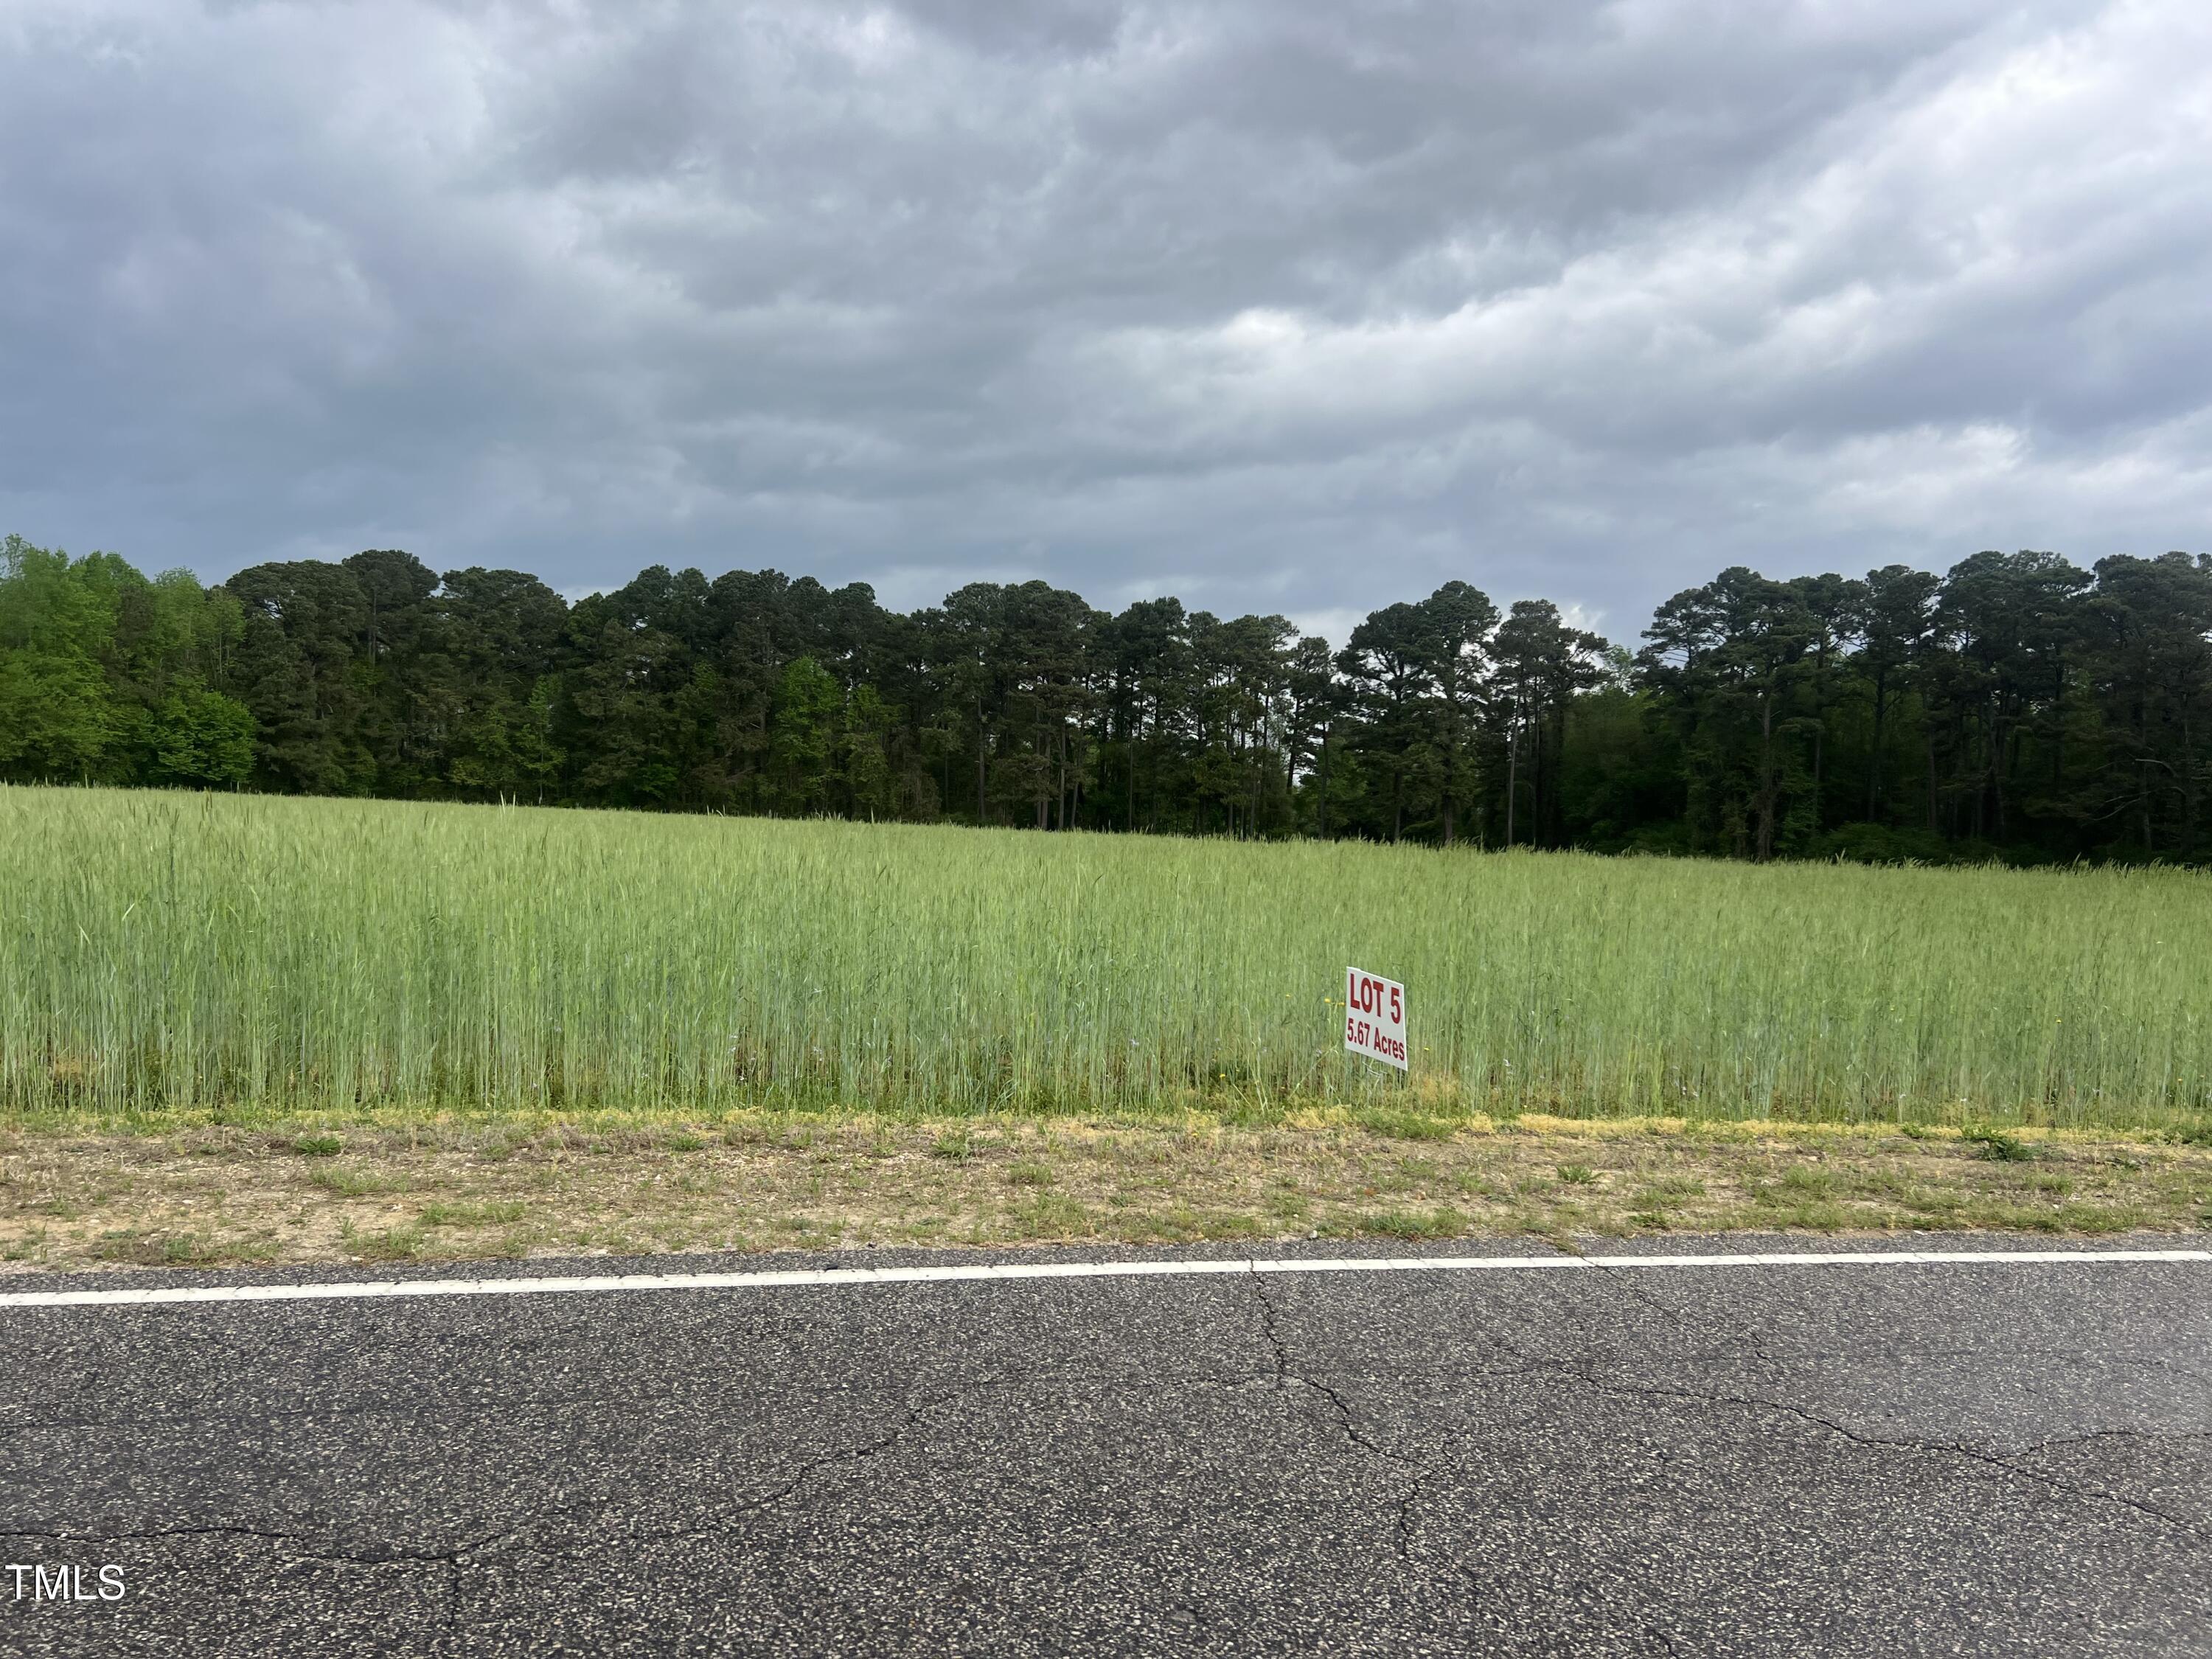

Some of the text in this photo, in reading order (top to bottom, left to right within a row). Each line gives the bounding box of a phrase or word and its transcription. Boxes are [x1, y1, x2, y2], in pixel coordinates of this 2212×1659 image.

[1350, 973, 1401, 1024] LOT 5
[1347, 1018, 1405, 1061] 5.67 Acres
